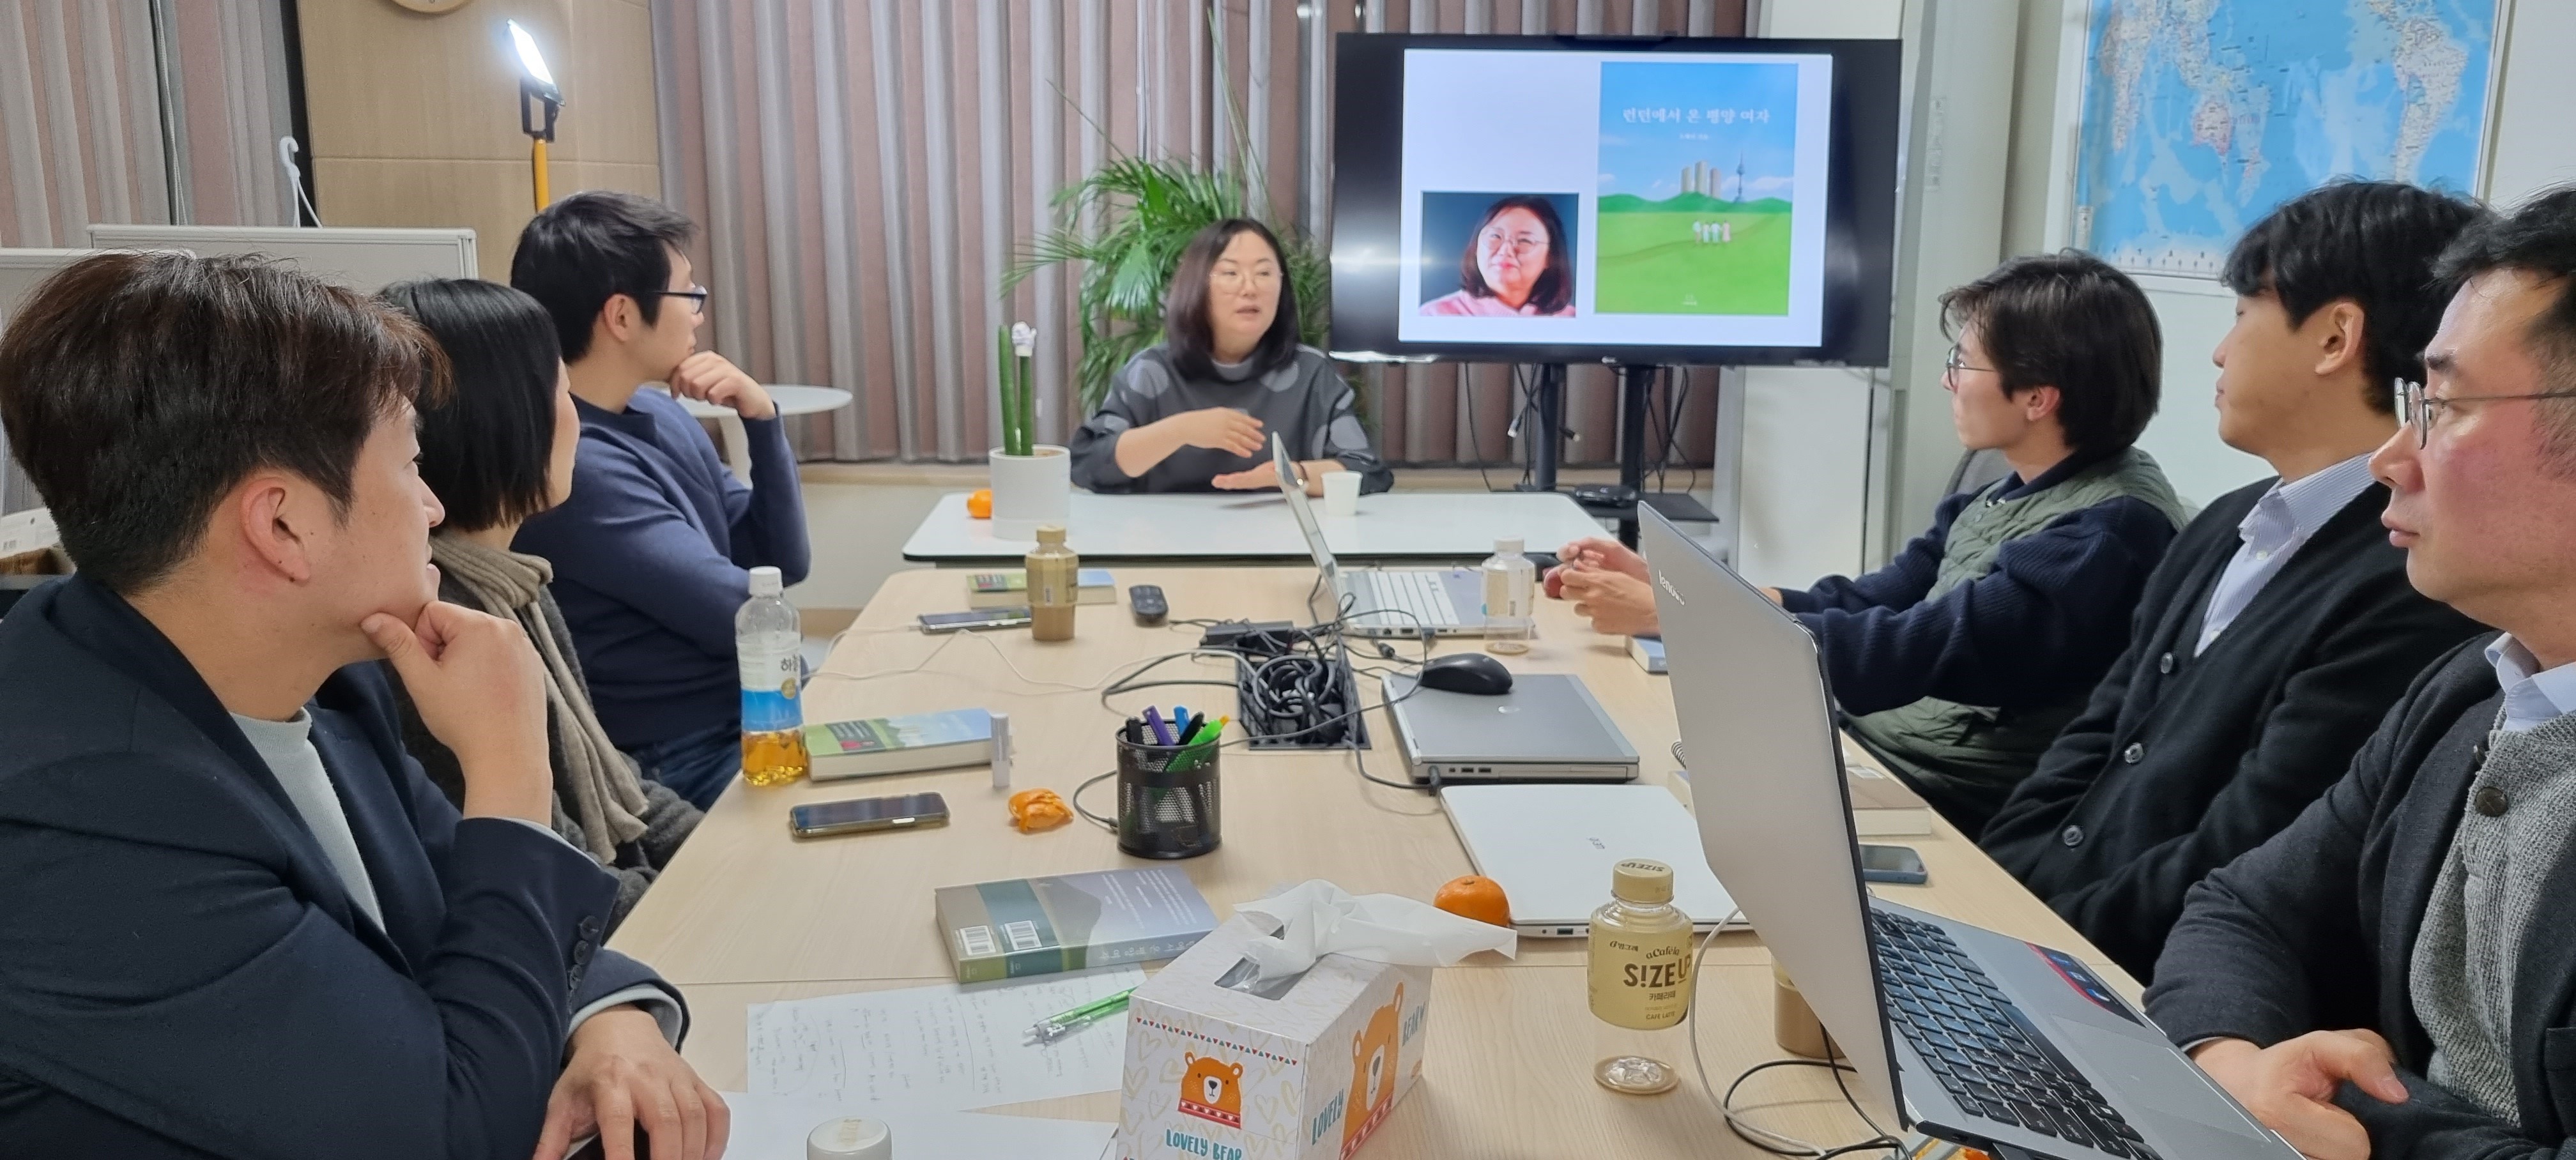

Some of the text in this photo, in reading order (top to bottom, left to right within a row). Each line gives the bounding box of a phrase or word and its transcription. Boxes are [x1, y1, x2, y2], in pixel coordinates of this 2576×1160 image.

[1623, 107, 1770, 124] 런던에서 온 평양 여자
[1312, 1088, 1344, 1146] LOVELY
[1165, 1129, 1209, 1157] LOVELY
